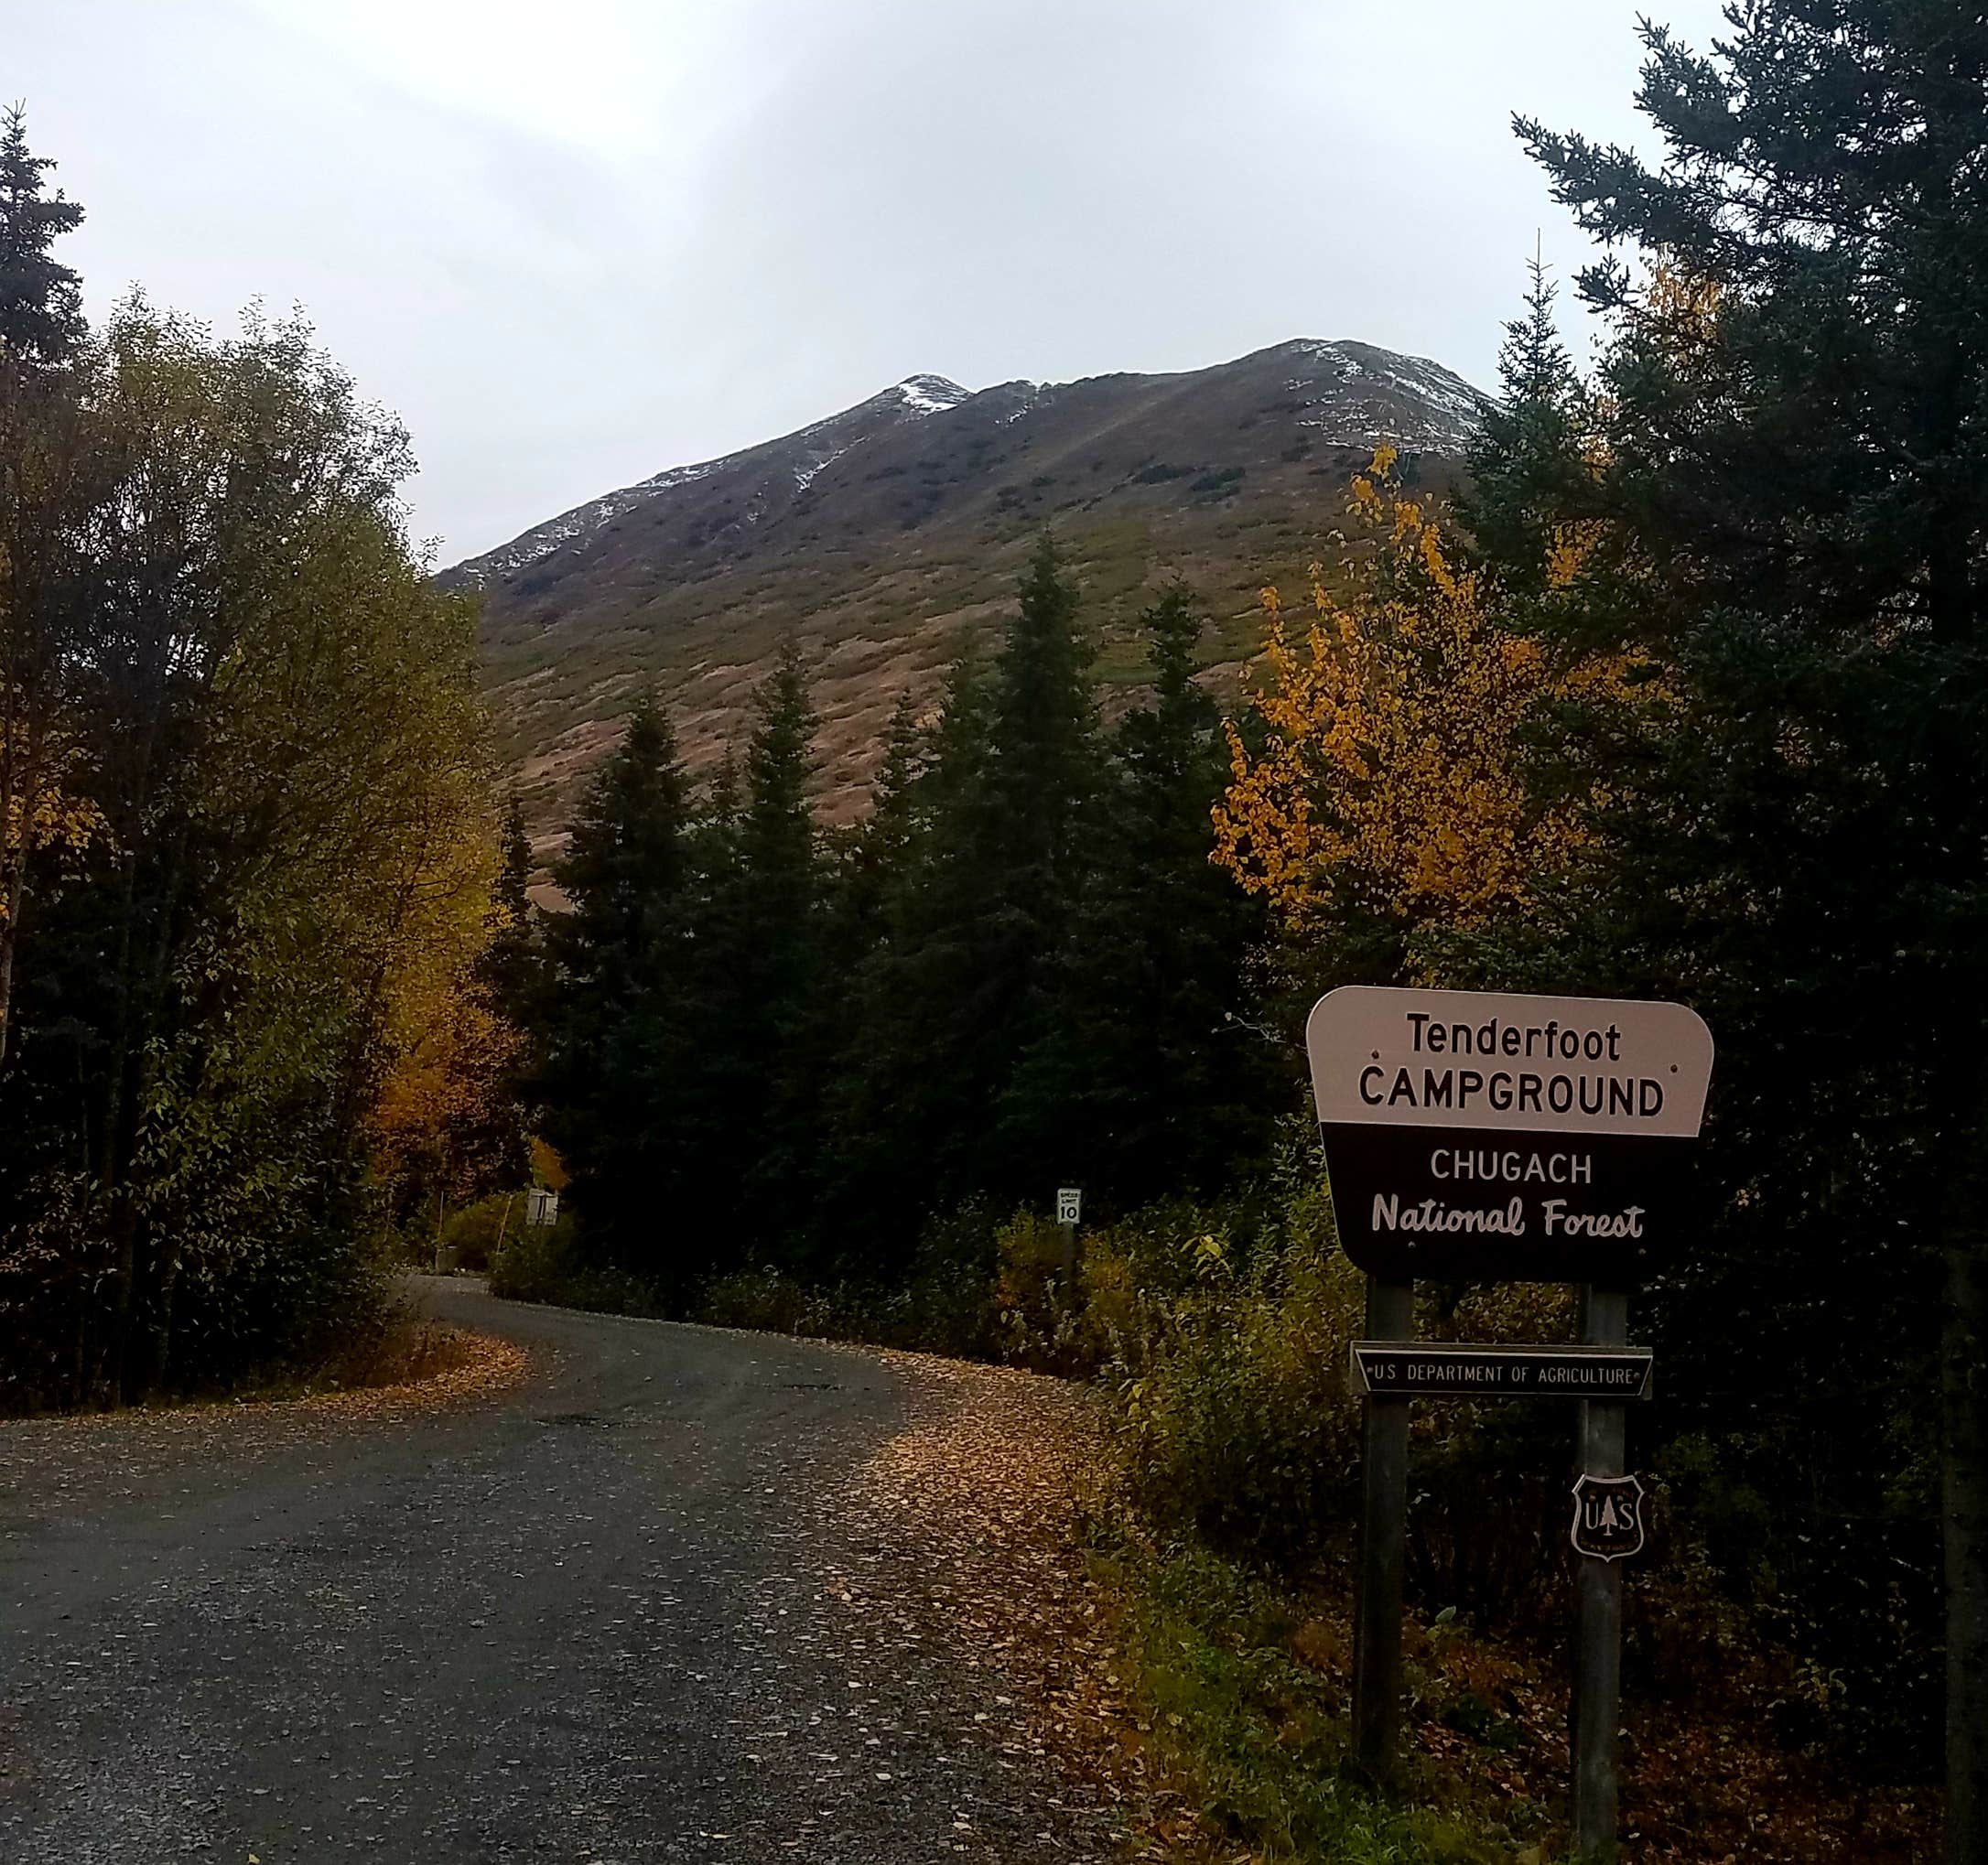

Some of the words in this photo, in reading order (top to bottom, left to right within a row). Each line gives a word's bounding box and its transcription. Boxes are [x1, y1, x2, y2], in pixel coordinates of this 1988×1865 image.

[1406, 1012, 1621, 1062] Tenderfoot
[1358, 1064, 1665, 1117] CAMPGROUND
[1431, 1148, 1592, 1184] CHUGACH
[1061, 1206, 1077, 1219] 10
[1372, 1193, 1526, 1236] National
[1541, 1198, 1646, 1238] Forest
[1407, 1364, 1503, 1383] DEPARTMENT
[1511, 1365, 1530, 1383] OF
[1538, 1367, 1634, 1385] AGRICULTURE
